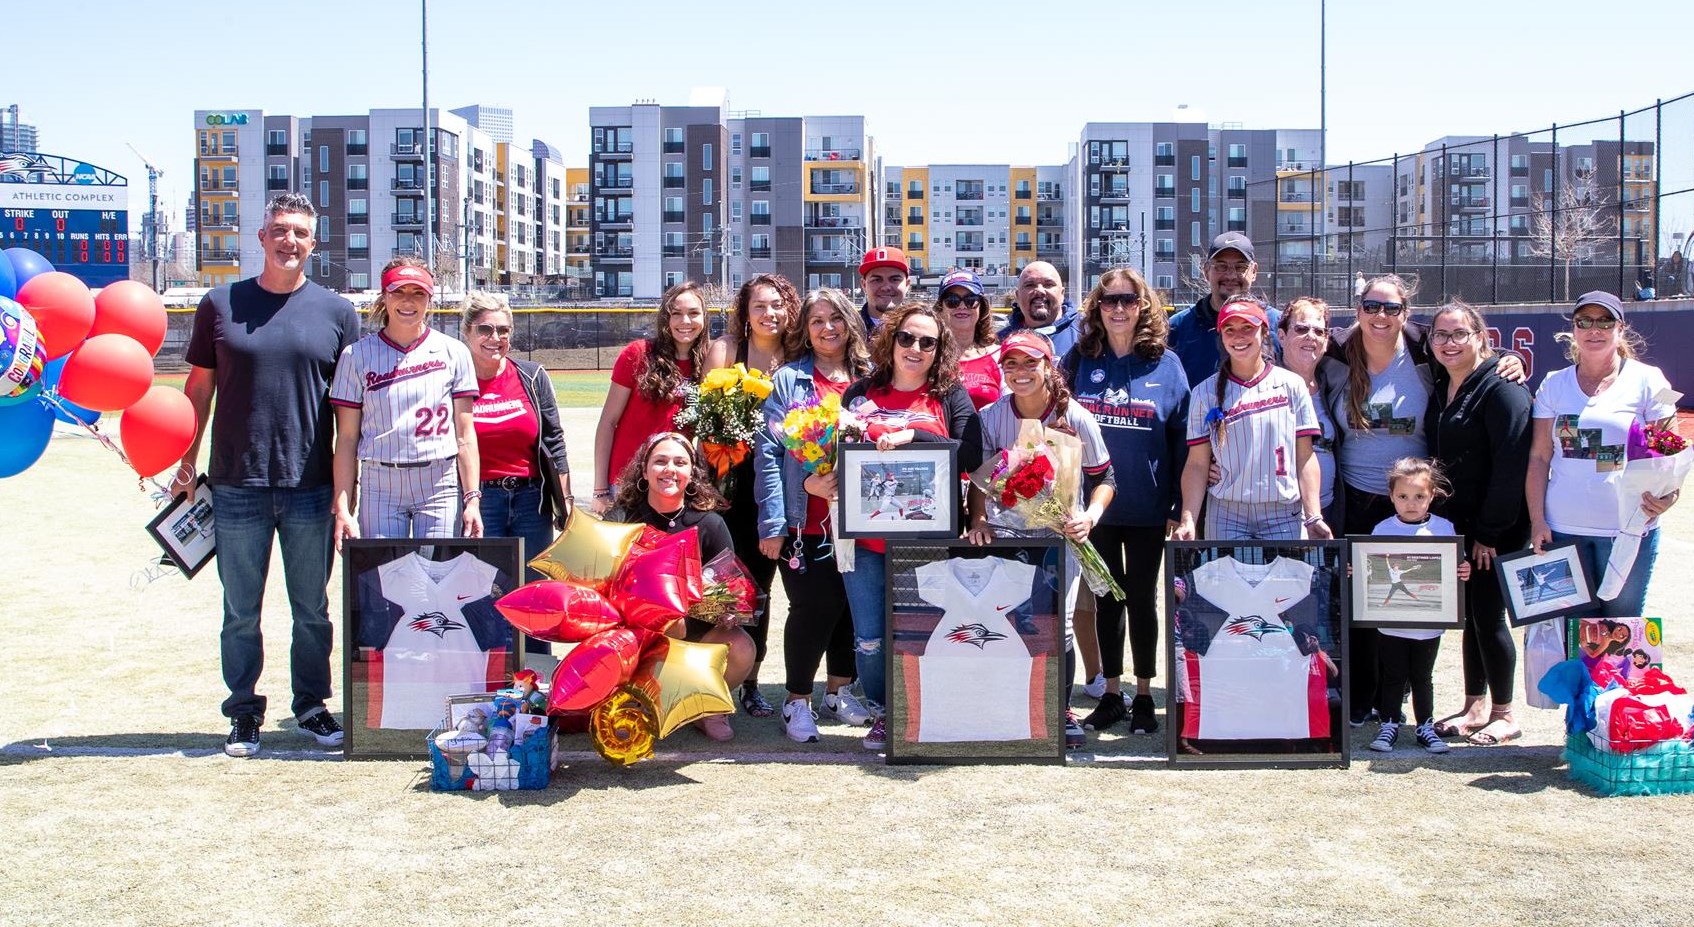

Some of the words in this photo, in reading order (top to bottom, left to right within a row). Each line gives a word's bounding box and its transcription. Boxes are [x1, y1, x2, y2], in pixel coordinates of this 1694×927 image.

[12, 192, 63, 201] ATHLETIC
[65, 193, 114, 202] COMPLEX
[4, 209, 35, 218] STRIKE
[52, 210, 70, 219] OUT
[102, 211, 116, 220] H/E
[57, 232, 65, 240] 10
[70, 232, 89, 240] RUNS
[366, 359, 447, 389] Roadrunners
[415, 405, 450, 437] 22
[1094, 413, 1139, 426] OFTBALL
[1275, 446, 1288, 476] 1
